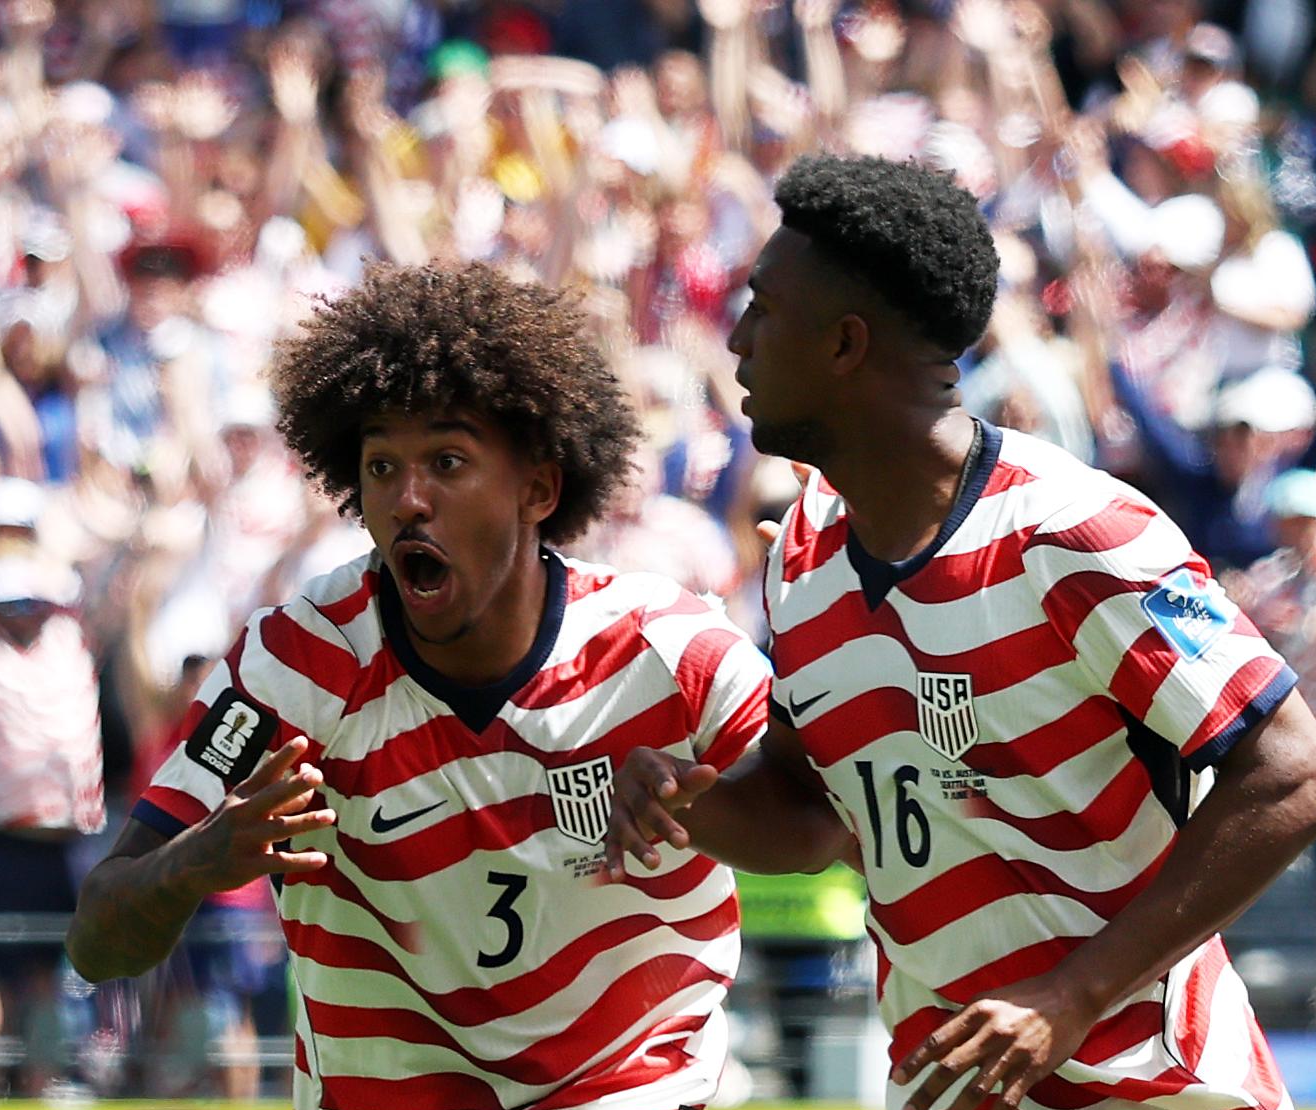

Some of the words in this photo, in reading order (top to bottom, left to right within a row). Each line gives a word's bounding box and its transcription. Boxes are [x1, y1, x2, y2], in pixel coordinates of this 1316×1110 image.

[920, 676, 969, 712] USA
[551, 760, 610, 799] USA
[854, 760, 931, 869] 16
[477, 870, 528, 969] 3
